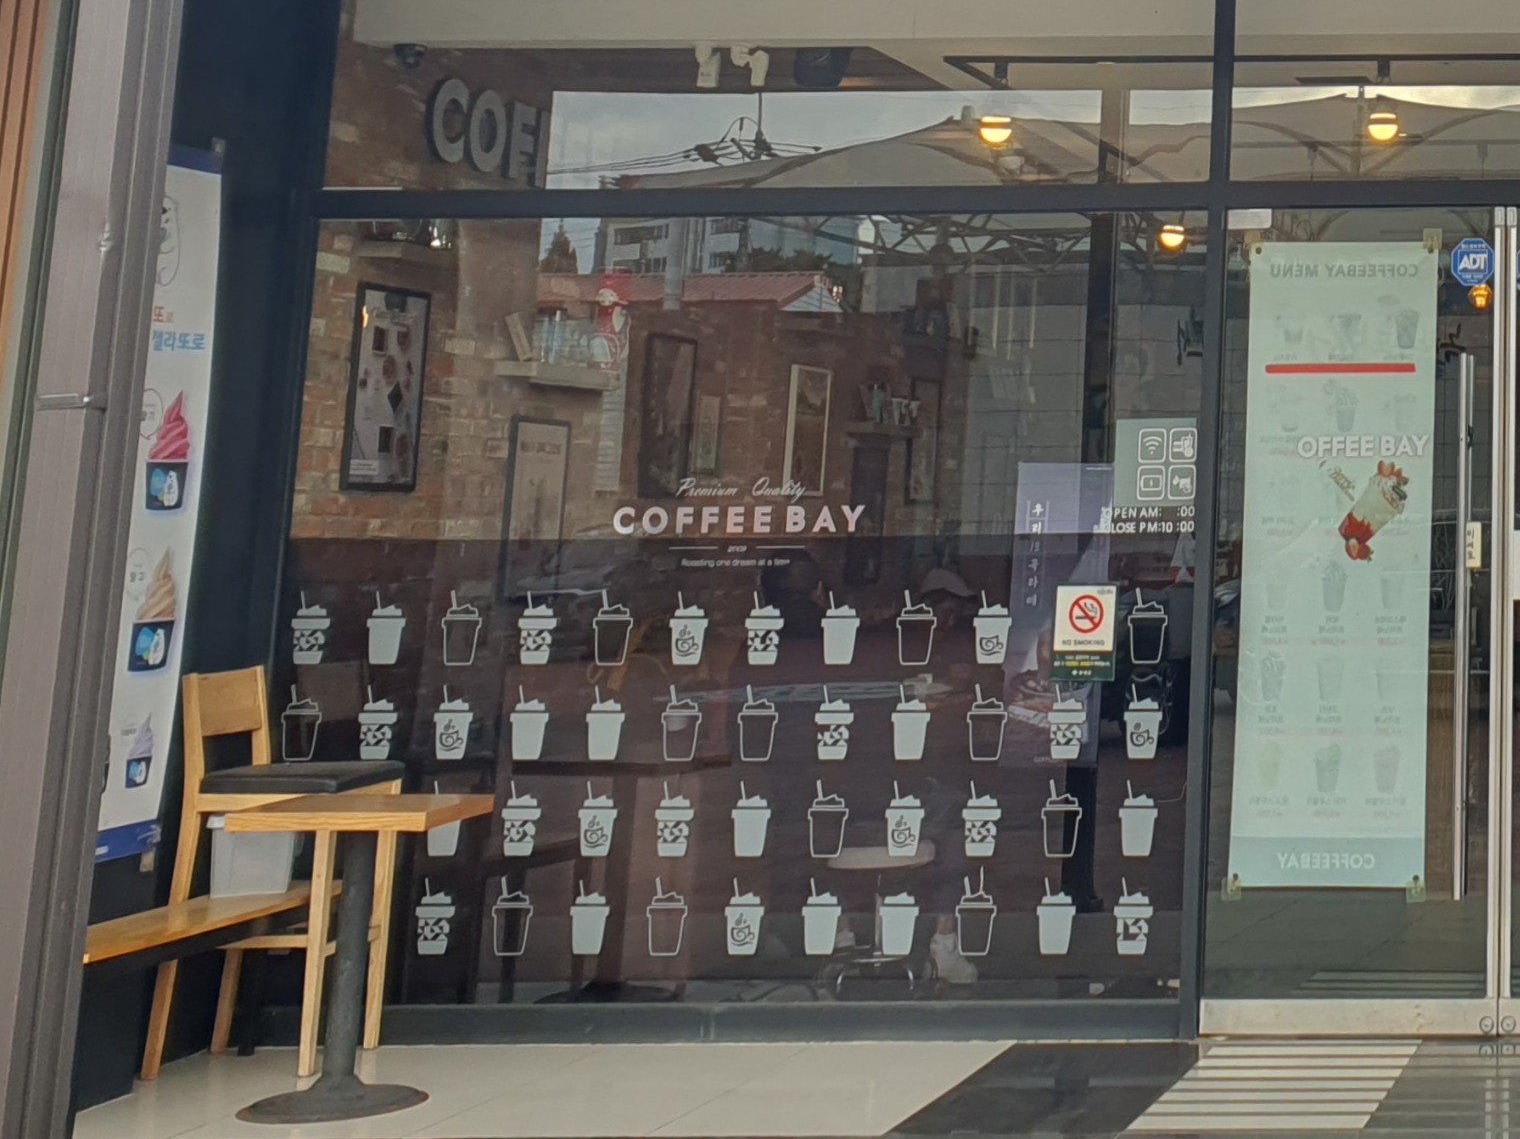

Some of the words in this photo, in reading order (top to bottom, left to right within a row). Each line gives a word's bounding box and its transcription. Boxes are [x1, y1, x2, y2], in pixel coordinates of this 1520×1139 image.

[1459, 253, 1488, 270] ADT
[1380, 434, 1429, 457] BAY
[675, 477, 739, 498] Premium
[752, 477, 806, 504] Quality
[785, 505, 867, 533] BAY
[1073, 639, 1106, 647] SMOKING
